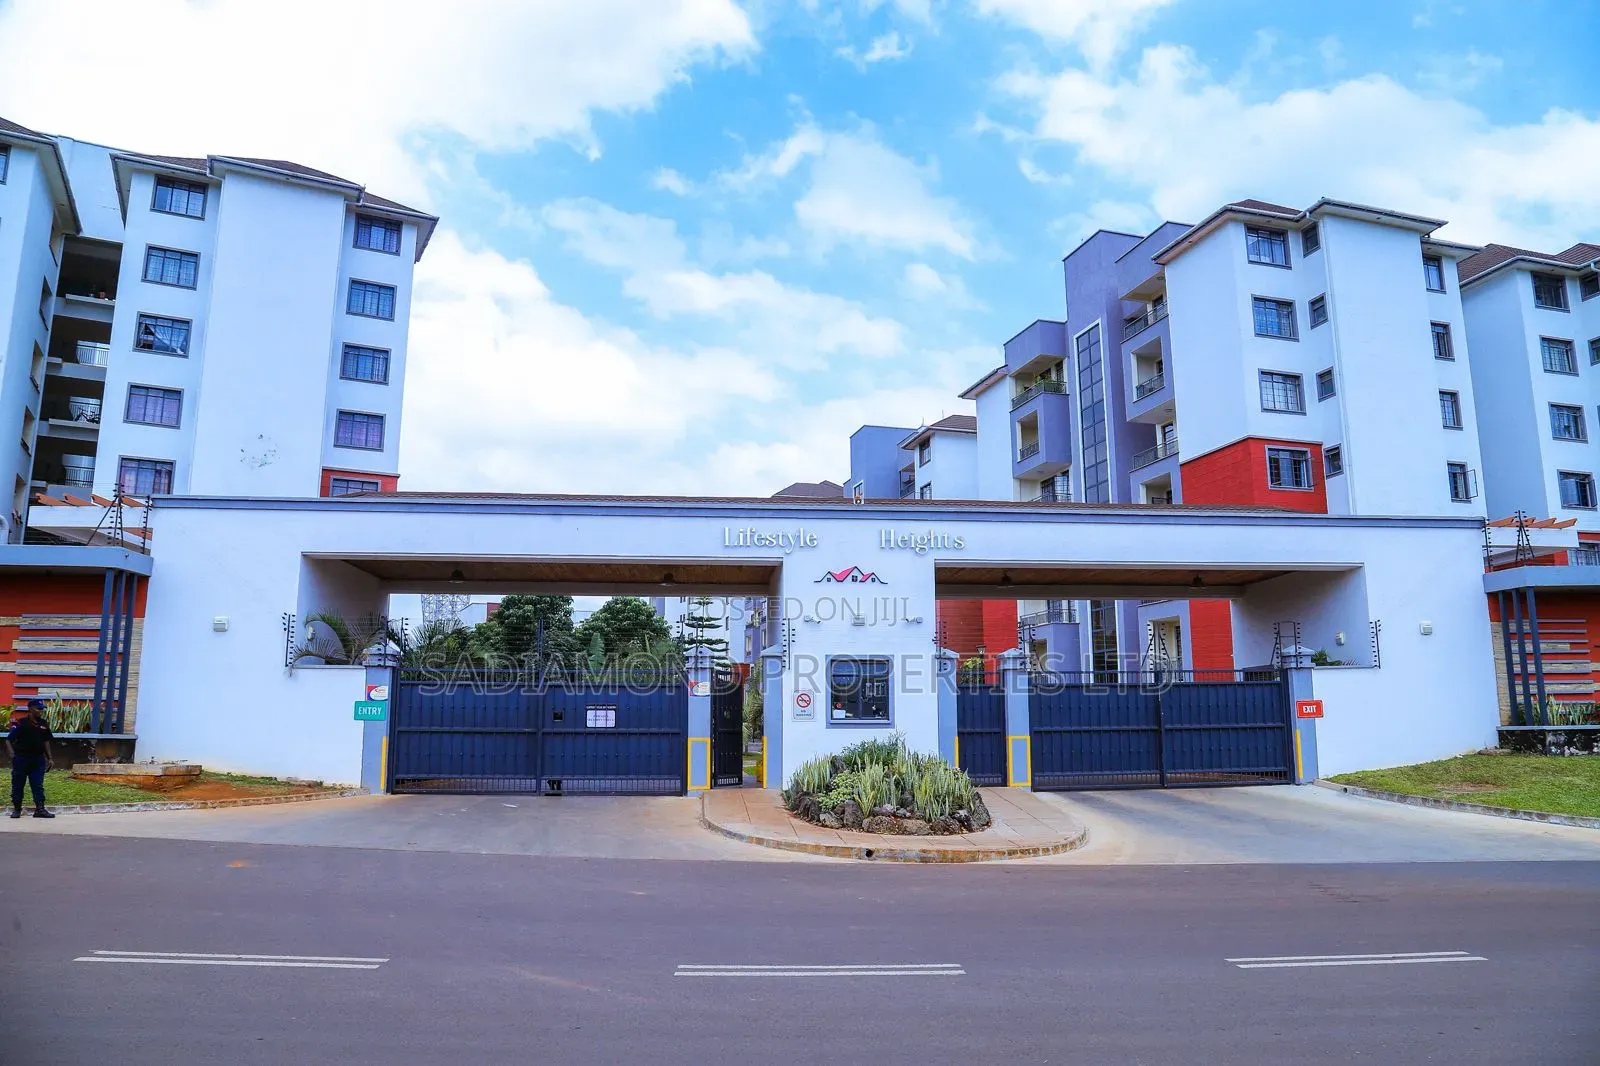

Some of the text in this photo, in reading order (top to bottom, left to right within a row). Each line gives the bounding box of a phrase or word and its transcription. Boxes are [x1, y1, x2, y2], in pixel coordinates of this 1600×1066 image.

[723, 526, 965, 555] Lifestyle Heights
[358, 706, 382, 715] ENTRY
[1302, 705, 1317, 713] EXIT
